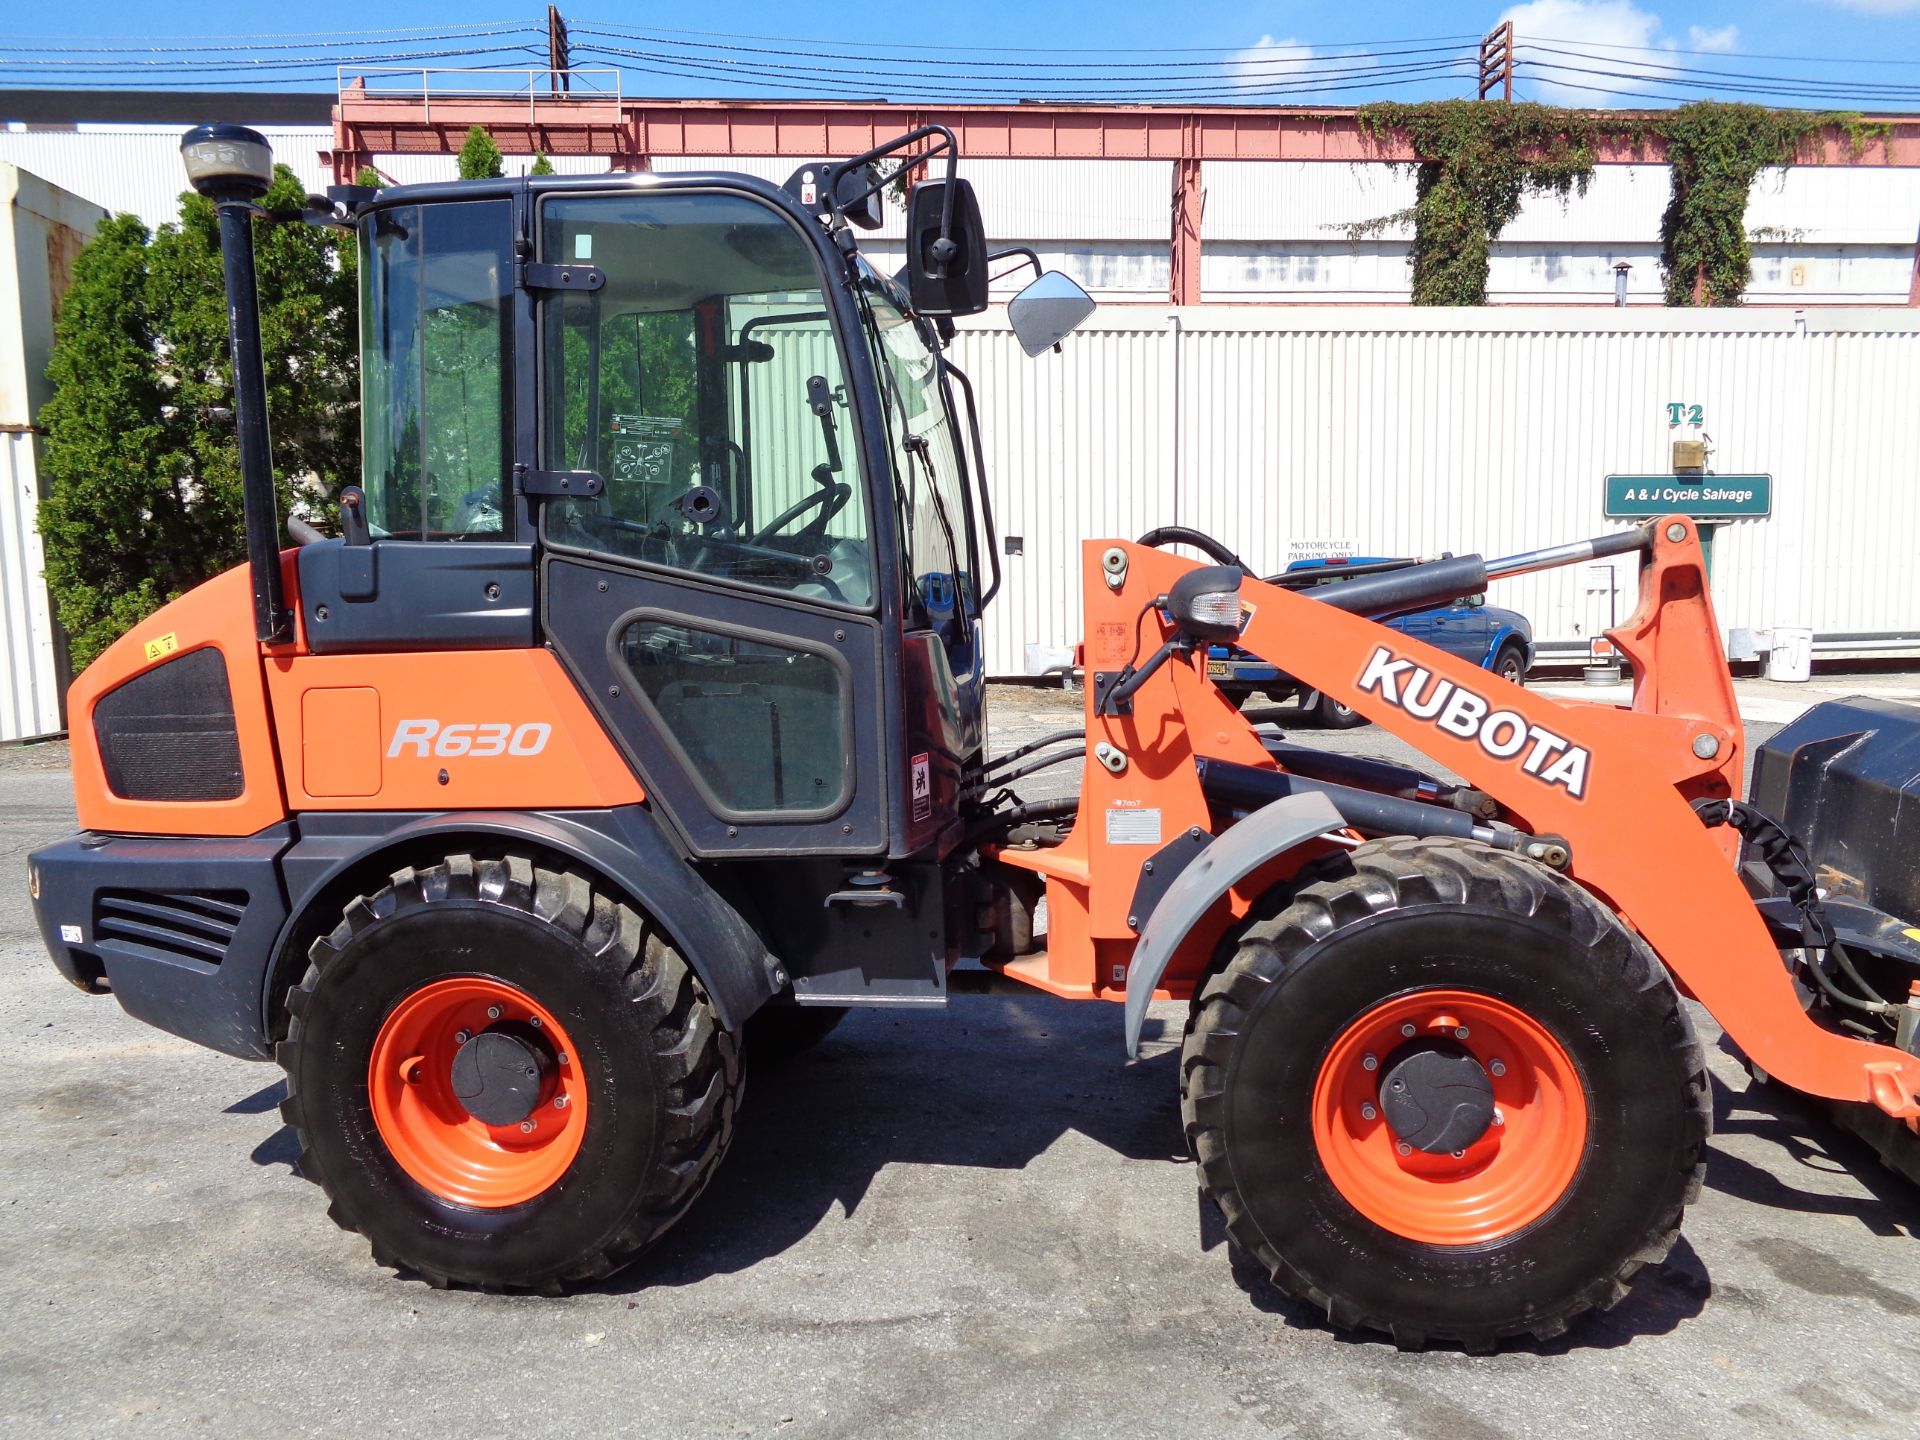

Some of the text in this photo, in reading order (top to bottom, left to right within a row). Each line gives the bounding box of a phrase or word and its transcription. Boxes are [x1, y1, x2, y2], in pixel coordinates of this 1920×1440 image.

[1624, 488, 1753, 503] A & J Cycle Salvage
[1290, 541, 1351, 550] MOTORCYCLE
[1288, 552, 1328, 560] PARKING
[1358, 646, 1593, 797] KUBOTA
[386, 718, 552, 758] R630
